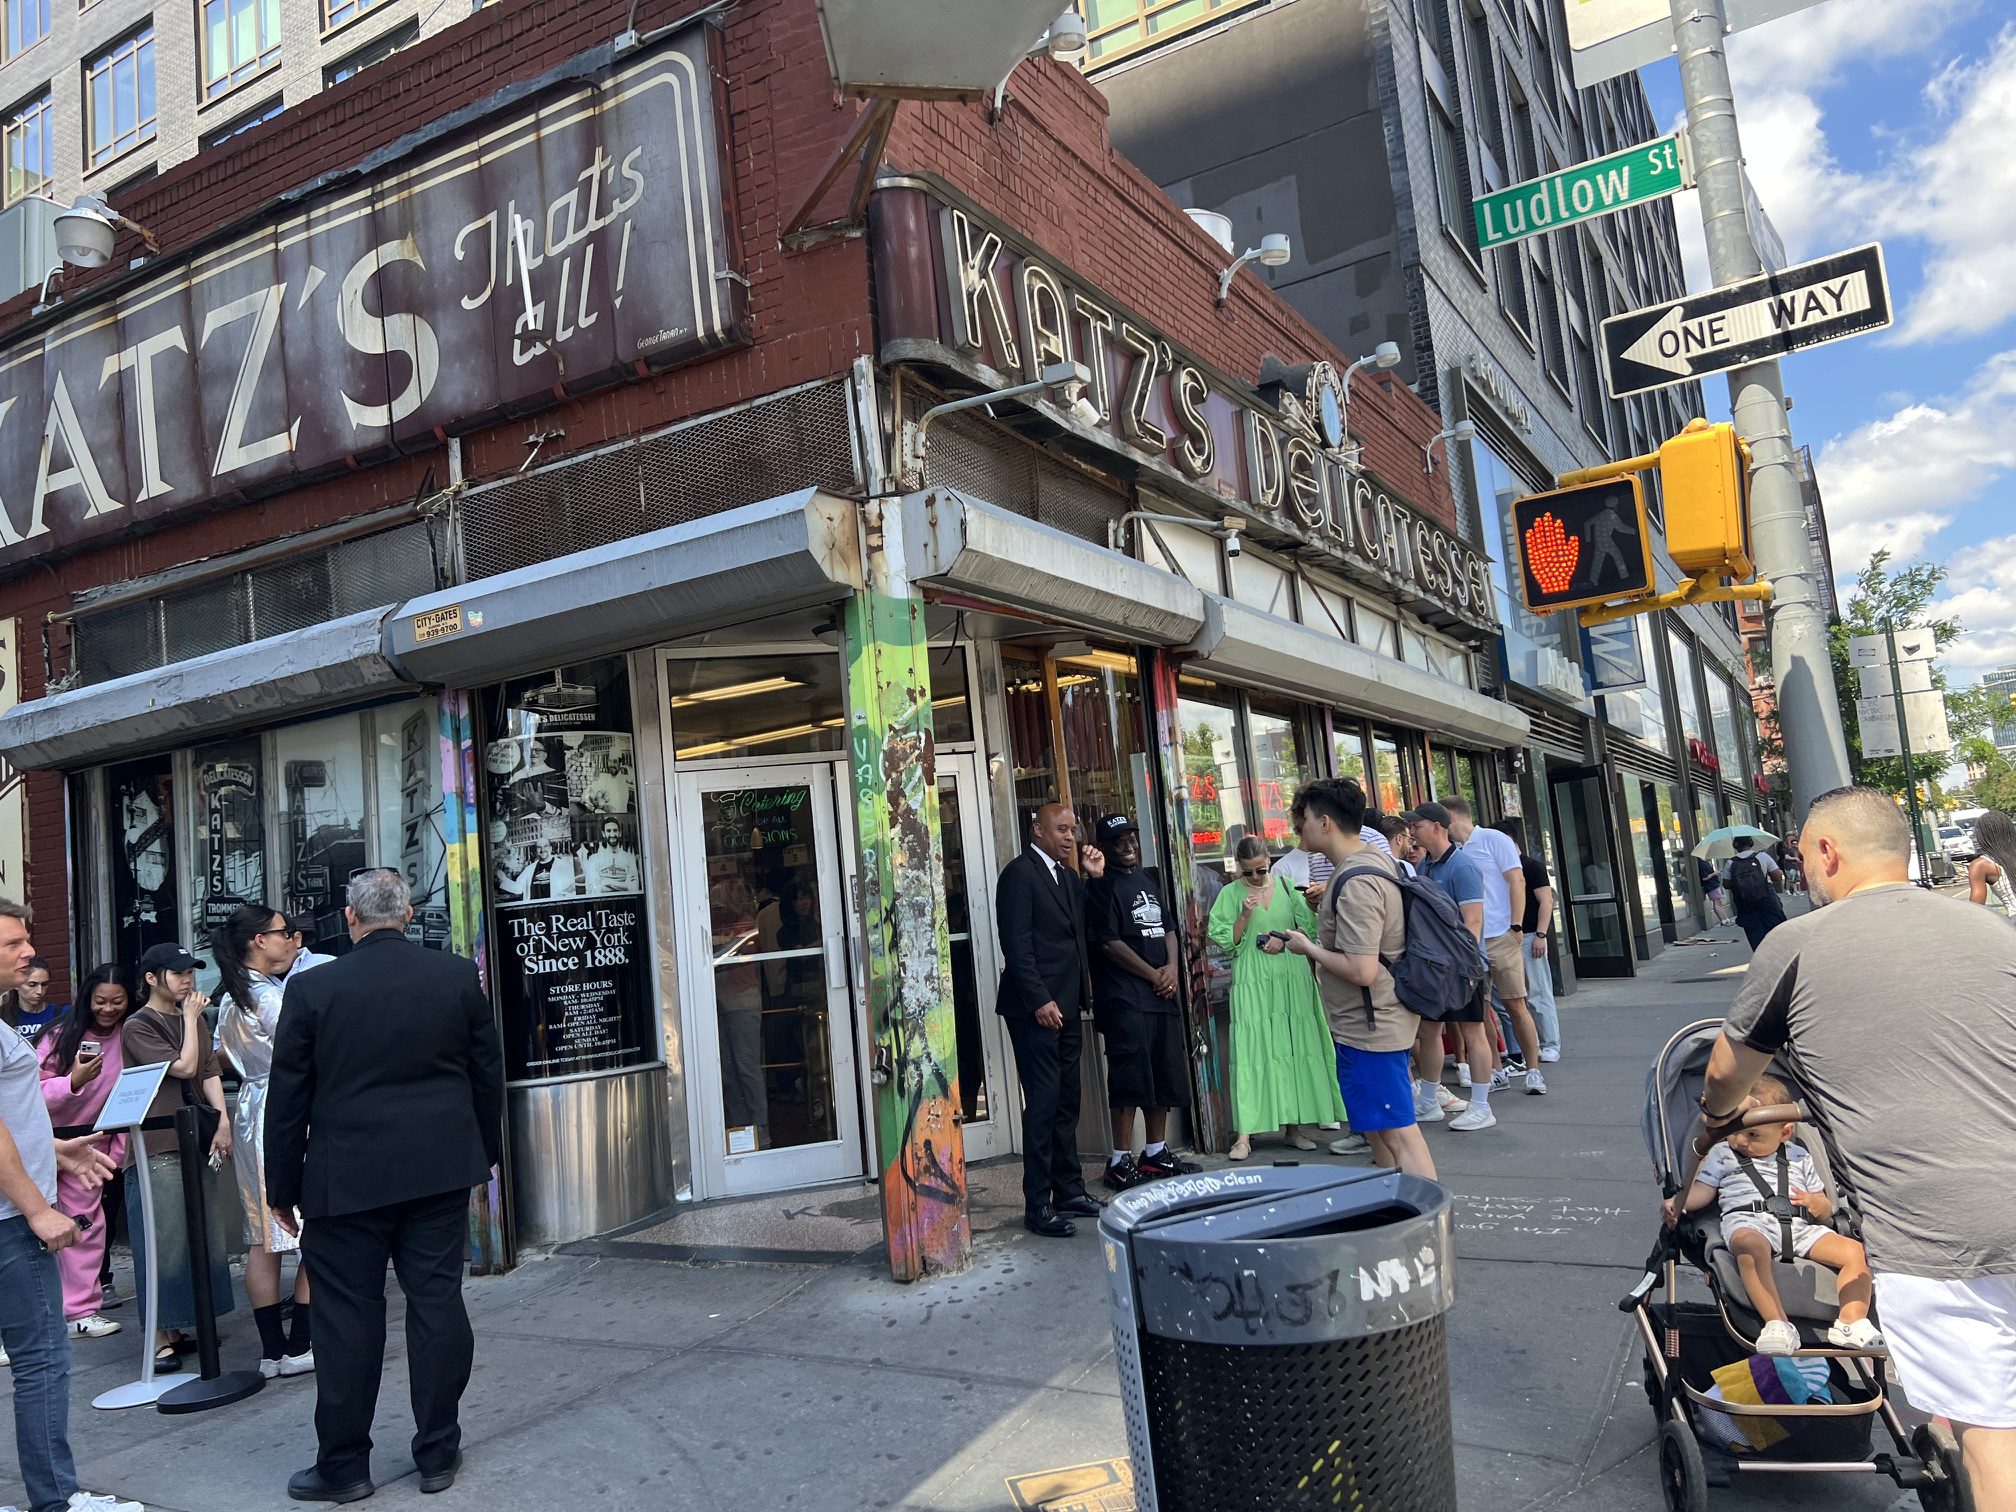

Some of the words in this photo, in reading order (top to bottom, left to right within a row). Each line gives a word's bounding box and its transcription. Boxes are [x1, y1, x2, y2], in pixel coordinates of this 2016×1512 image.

[1482, 165, 1630, 241] Ludlow
[1647, 144, 1675, 175] St
[454, 145, 644, 310] That's
[1657, 314, 1730, 359] ONE
[1767, 278, 1850, 330] WAY
[1821, 320, 1885, 341] TRANSPORTATION
[950, 207, 1216, 475] KATZ'S
[0, 233, 443, 549] ATZ'S
[416, 608, 458, 629] CITY-GATES
[549, 713, 596, 722] DELICATESSEN
[740, 788, 807, 817] Catering
[723, 828, 798, 848] OCCSIONS
[508, 917, 546, 938] The
[550, 911, 594, 934] Real
[596, 909, 636, 929] Taste
[516, 935, 538, 956] of
[540, 934, 587, 954] New
[589, 927, 633, 948] York.
[524, 954, 580, 975] Since
[583, 946, 629, 969] 1888.
[547, 994, 576, 1002] MONDAY
[580, 989, 616, 998] WEDNESDAY
[549, 984, 581, 995] STORE
[582, 980, 613, 991] HOURS
[568, 1002, 600, 1011] THURSDAY
[567, 1020, 585, 1028] OPEN
[573, 1014, 597, 1022] FRIDAY
[569, 1024, 602, 1033] SATURDAY
[582, 1030, 594, 1038] ALL
[555, 1044, 573, 1052] OPEN
[574, 1041, 593, 1049] UNTIL
[574, 1036, 599, 1044] SUNDAY
[1223, 1172, 1262, 1187] Clean
